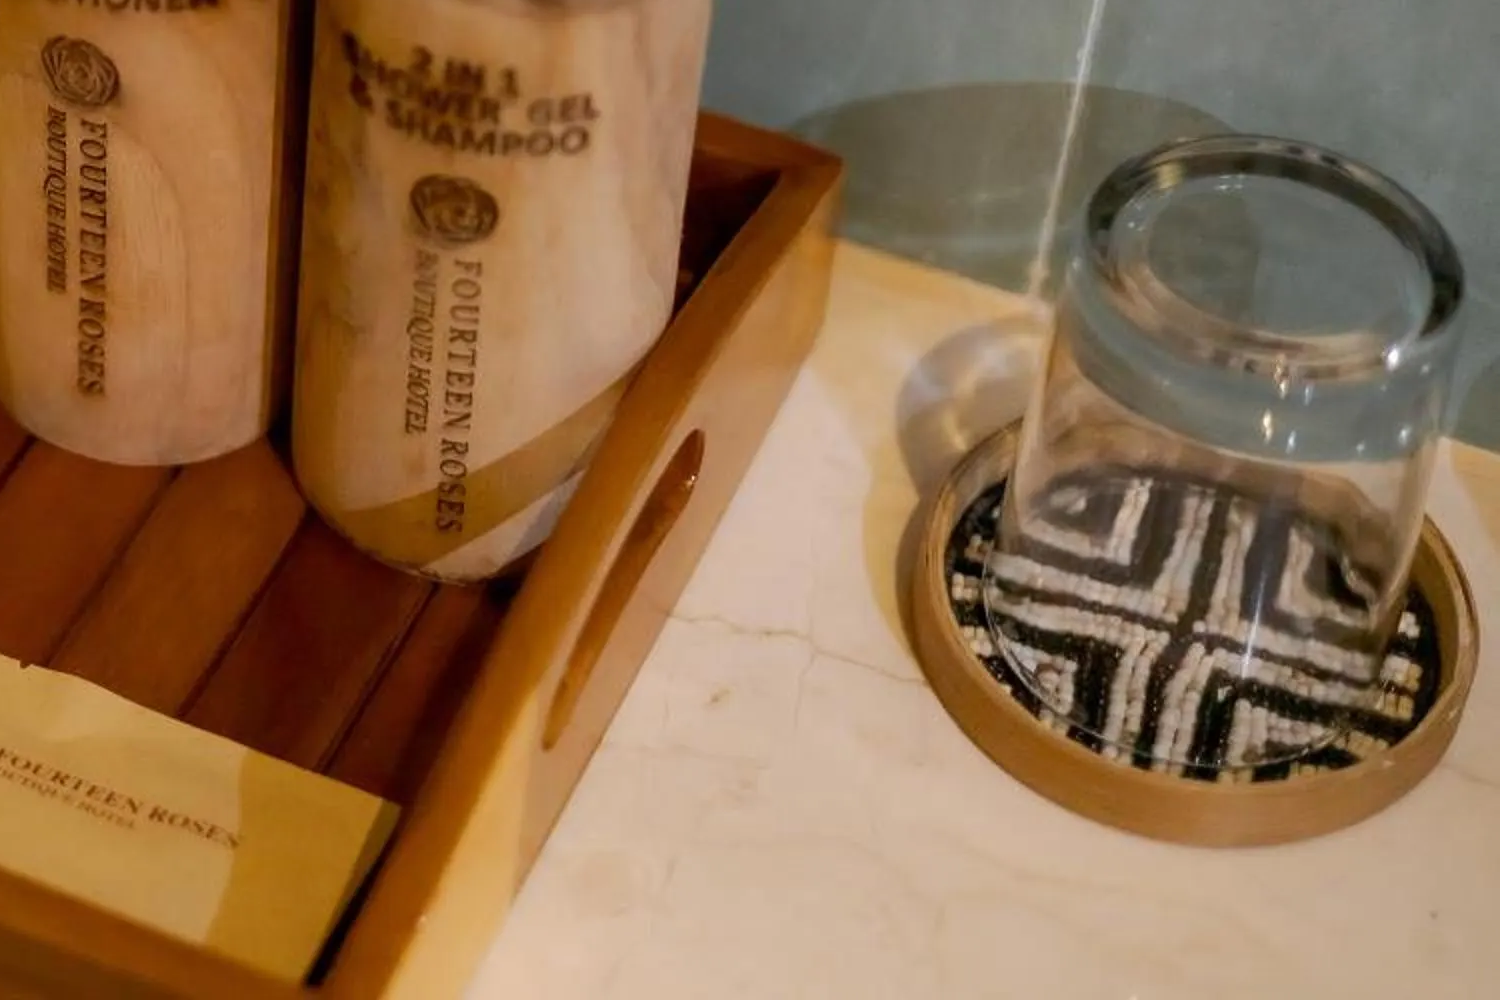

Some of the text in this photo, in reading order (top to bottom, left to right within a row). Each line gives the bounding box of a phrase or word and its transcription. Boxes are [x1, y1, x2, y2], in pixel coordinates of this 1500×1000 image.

[410, 44, 433, 75] 2
[527, 91, 601, 126] GEL
[386, 98, 590, 157] SHAMPOO
[43, 106, 69, 295] BOUTIQUE HOTEL
[77, 116, 109, 397] FOURTEEN ROSES
[405, 249, 439, 435] BOUTIQUE HOTEL
[435, 257, 482, 535] FOURTEEN ROSES
[148, 804, 243, 850] ROSES
